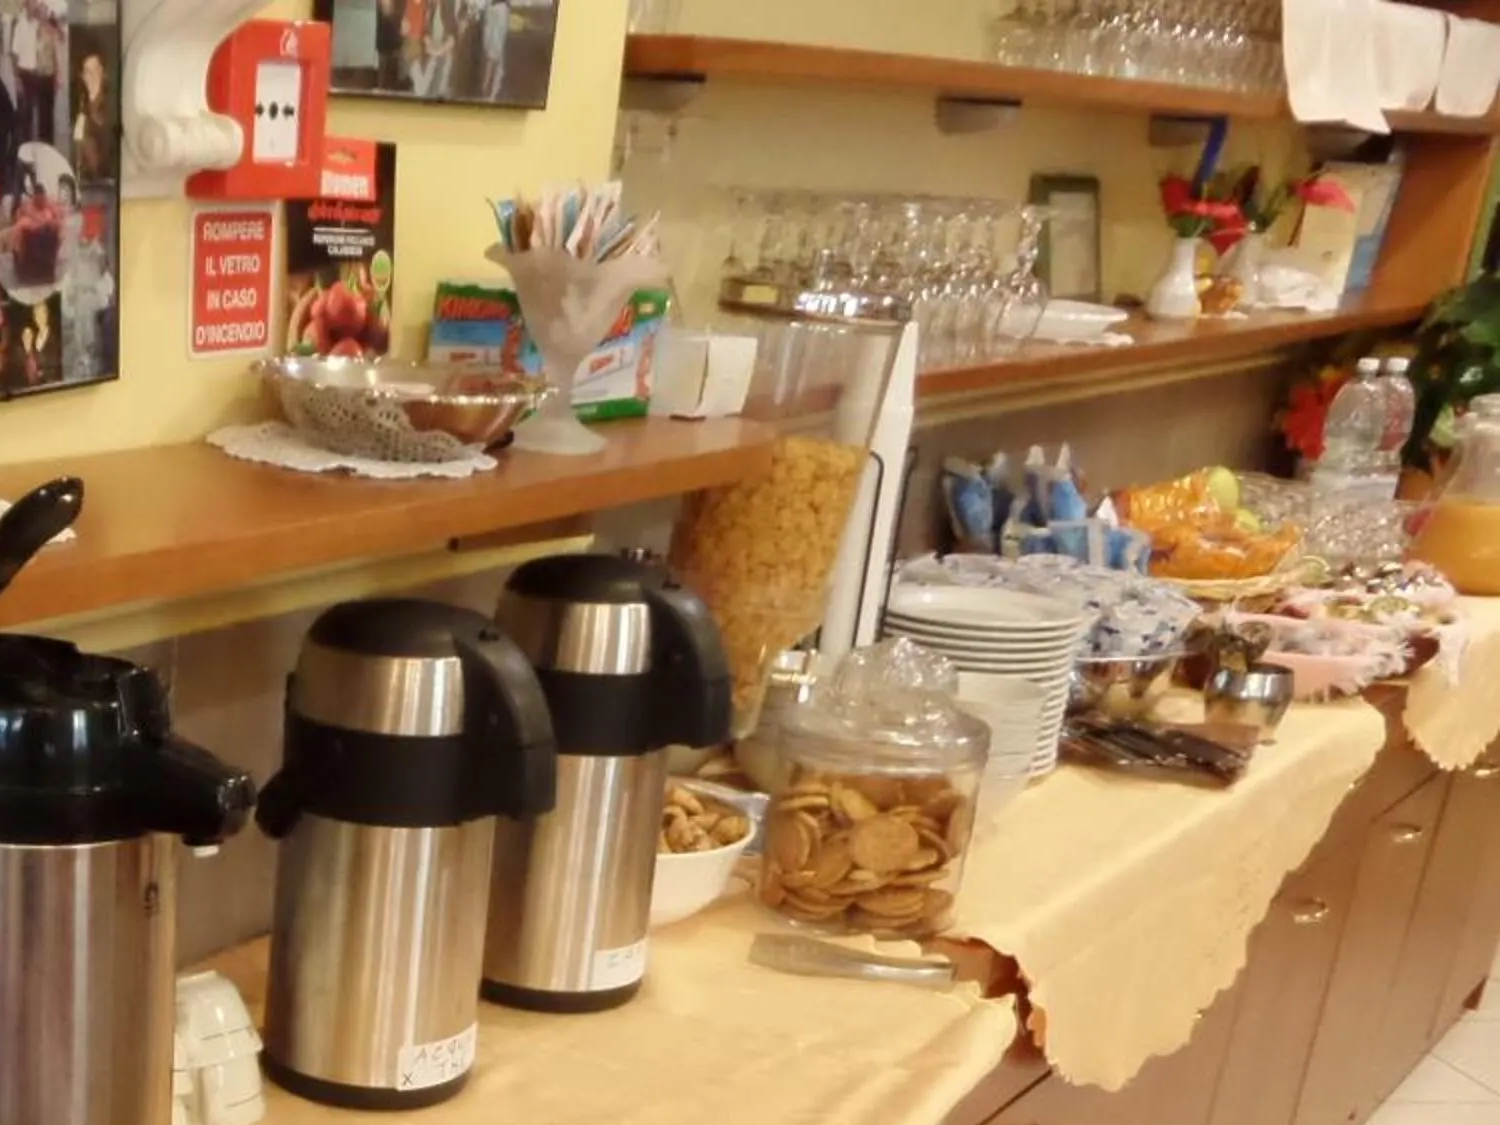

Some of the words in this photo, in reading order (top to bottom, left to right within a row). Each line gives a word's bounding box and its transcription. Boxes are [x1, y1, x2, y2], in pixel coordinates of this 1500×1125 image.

[202, 220, 265, 241] ROMPERE
[205, 255, 217, 276] IL
[219, 253, 261, 275] VETRO
[206, 289, 220, 311] IN
[222, 287, 257, 310] CASO
[195, 319, 265, 345] D'INCENDIO
